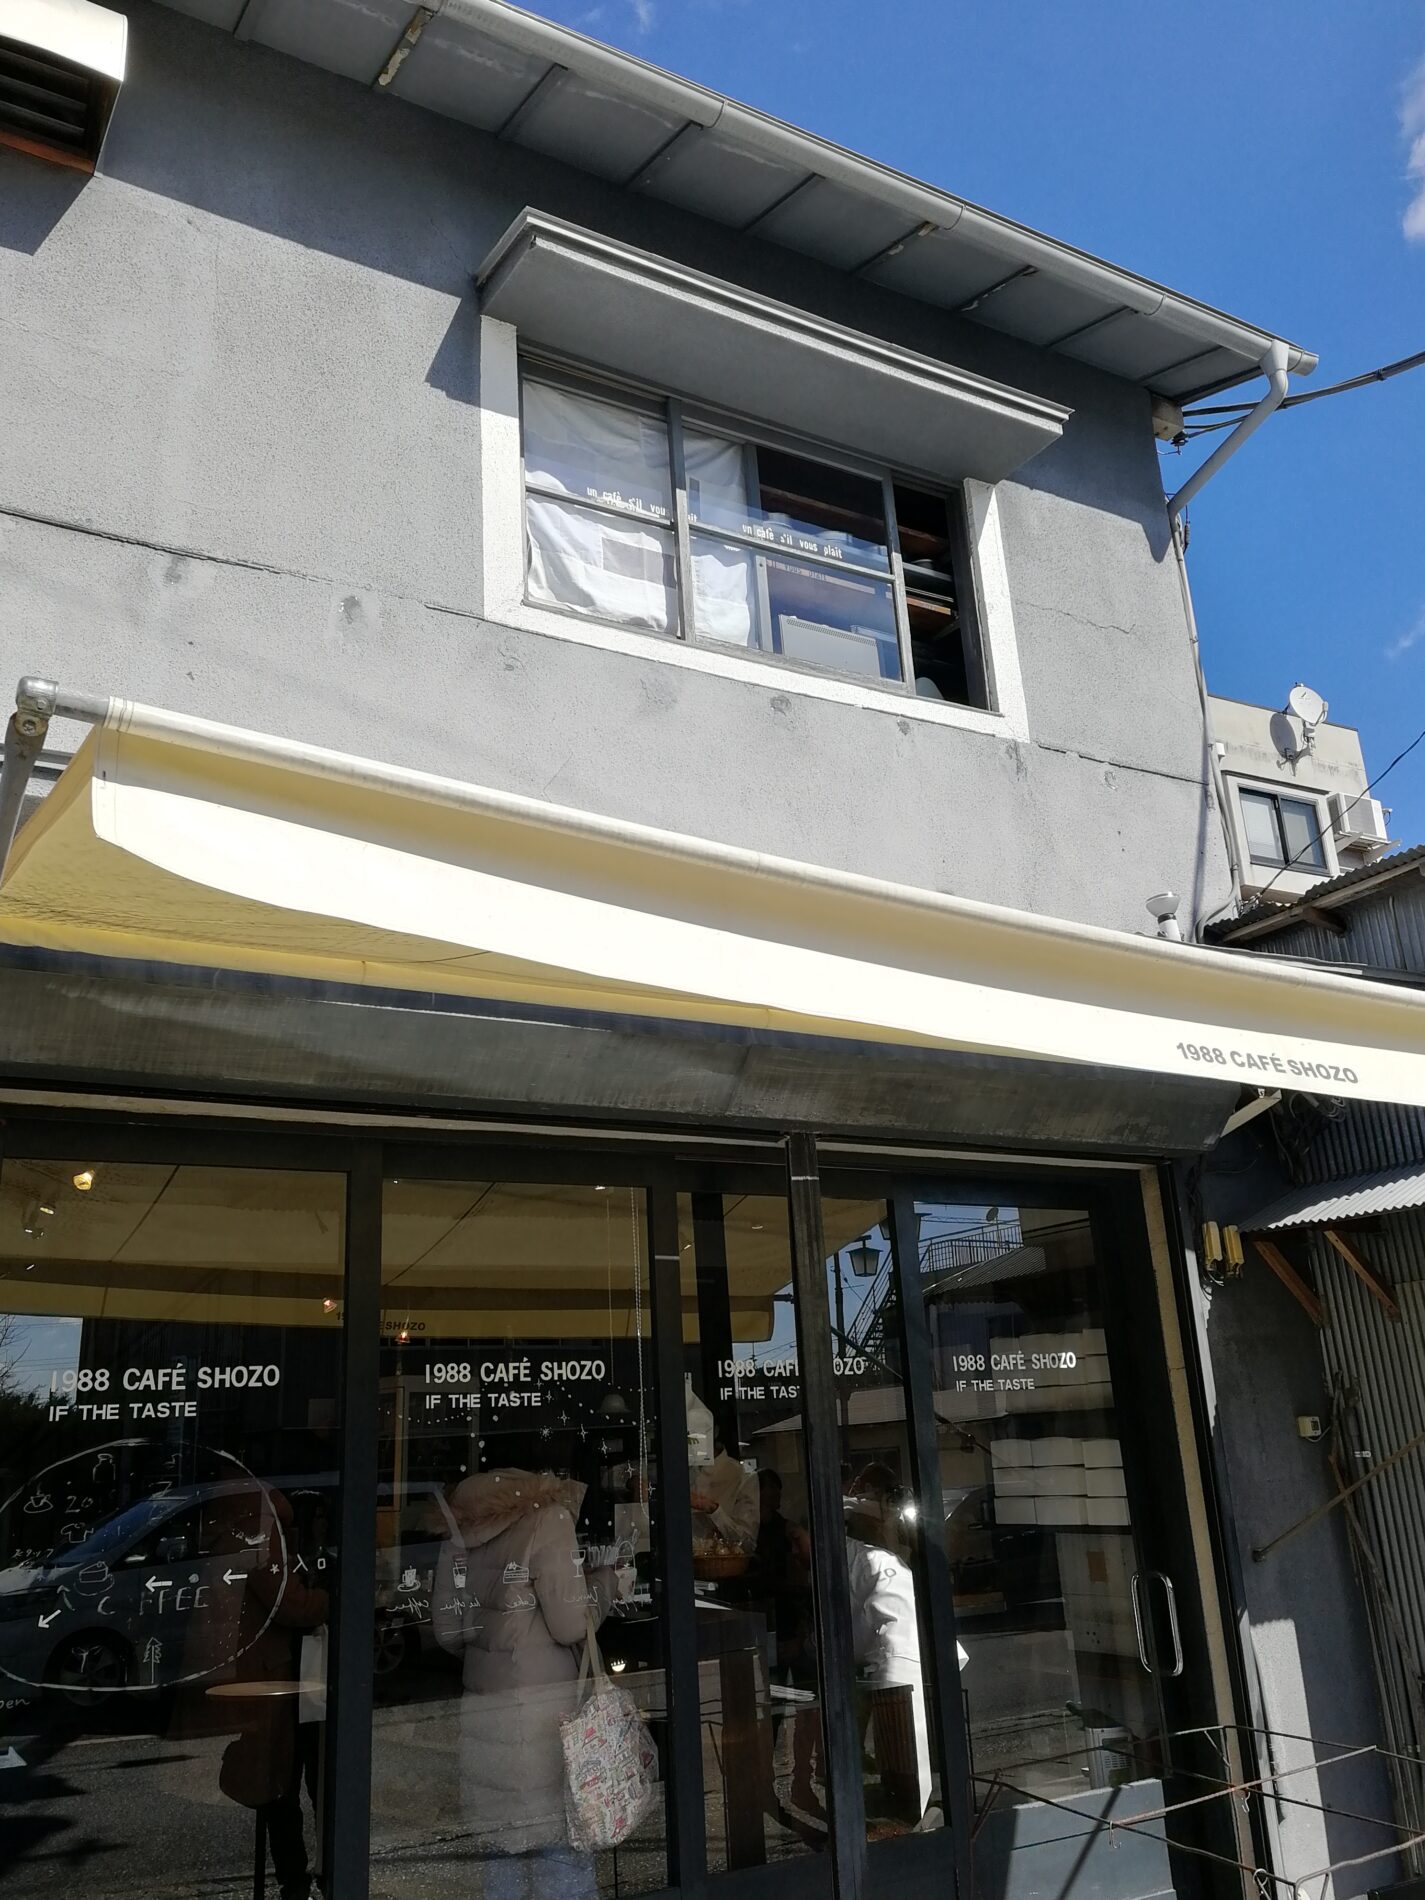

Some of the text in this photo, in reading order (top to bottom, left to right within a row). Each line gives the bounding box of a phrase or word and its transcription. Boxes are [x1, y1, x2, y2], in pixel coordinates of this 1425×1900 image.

[586, 486, 597, 498] un
[742, 524, 753, 536] un
[799, 539, 818, 552] vous
[1176, 1042, 1359, 1085] 1988 CAFÉ SHOZO
[425, 1357, 606, 1384] 1988 CAFÉ SHOZO
[717, 1359, 756, 1378] 1988
[832, 1356, 865, 1376] OZO
[952, 1350, 1077, 1372] 1988 CAFÉ SHOZO
[50, 1362, 281, 1393] 1988 CAFÉ SHOZO
[955, 1378, 1036, 1393] IF THE TASTE
[426, 1392, 542, 1409] IF THE TASTE
[720, 1385, 800, 1400] IF THE TAS
[48, 1401, 198, 1422] IF THE TASTE
